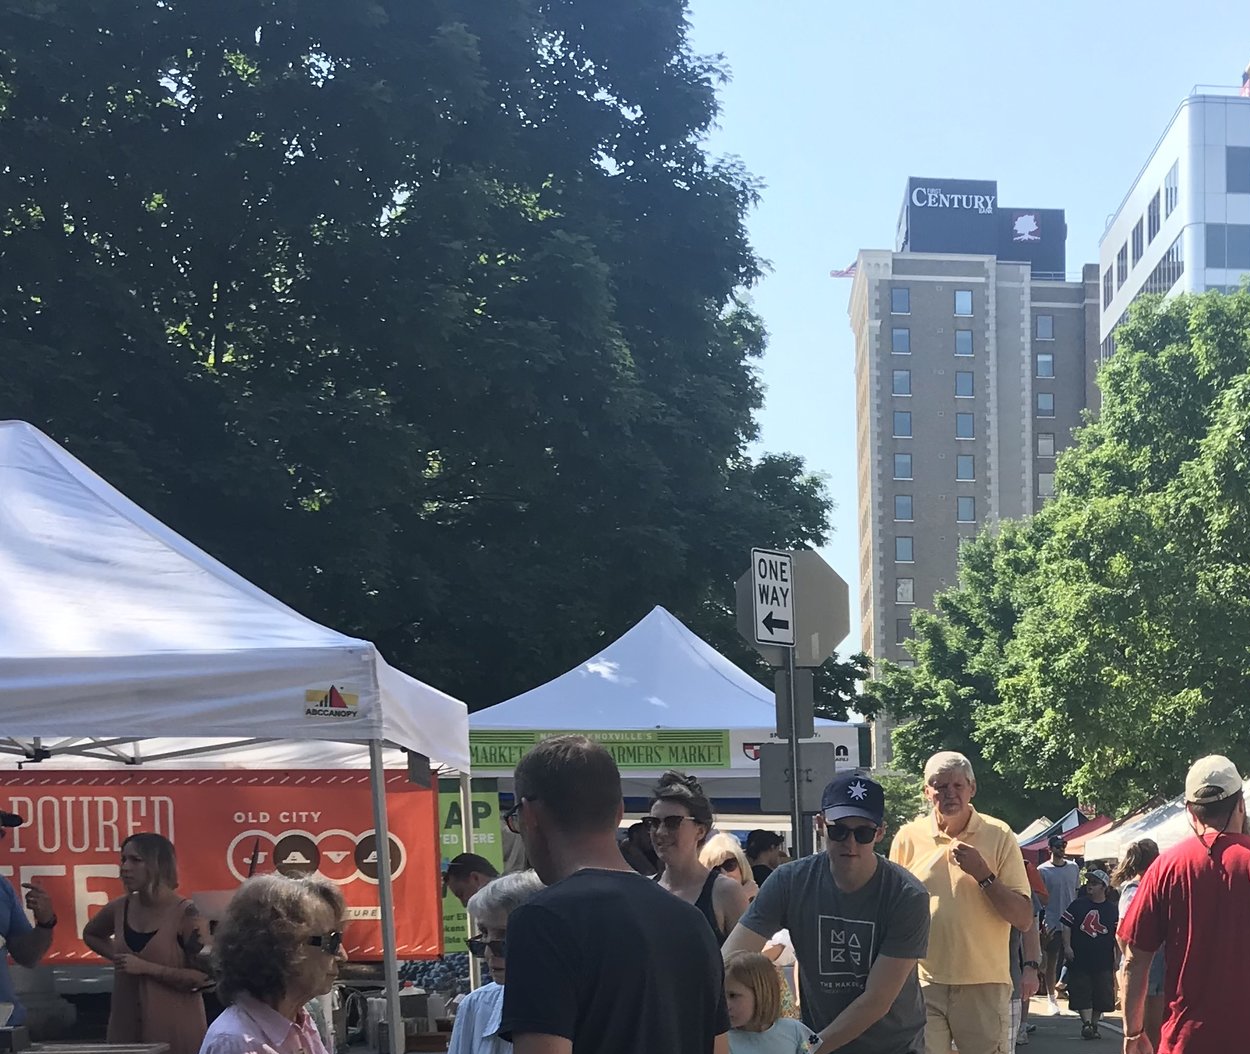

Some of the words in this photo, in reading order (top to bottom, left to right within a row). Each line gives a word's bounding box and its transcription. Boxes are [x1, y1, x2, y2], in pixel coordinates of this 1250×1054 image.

[912, 187, 995, 209] CENTURY
[758, 558, 788, 582] ONE
[758, 583, 790, 608] WAY
[305, 708, 358, 717] ABCCANOPY
[609, 745, 664, 763] ARMERS'
[669, 745, 723, 763] MARKET
[233, 812, 270, 823] OLD
[280, 812, 322, 823] CITY
